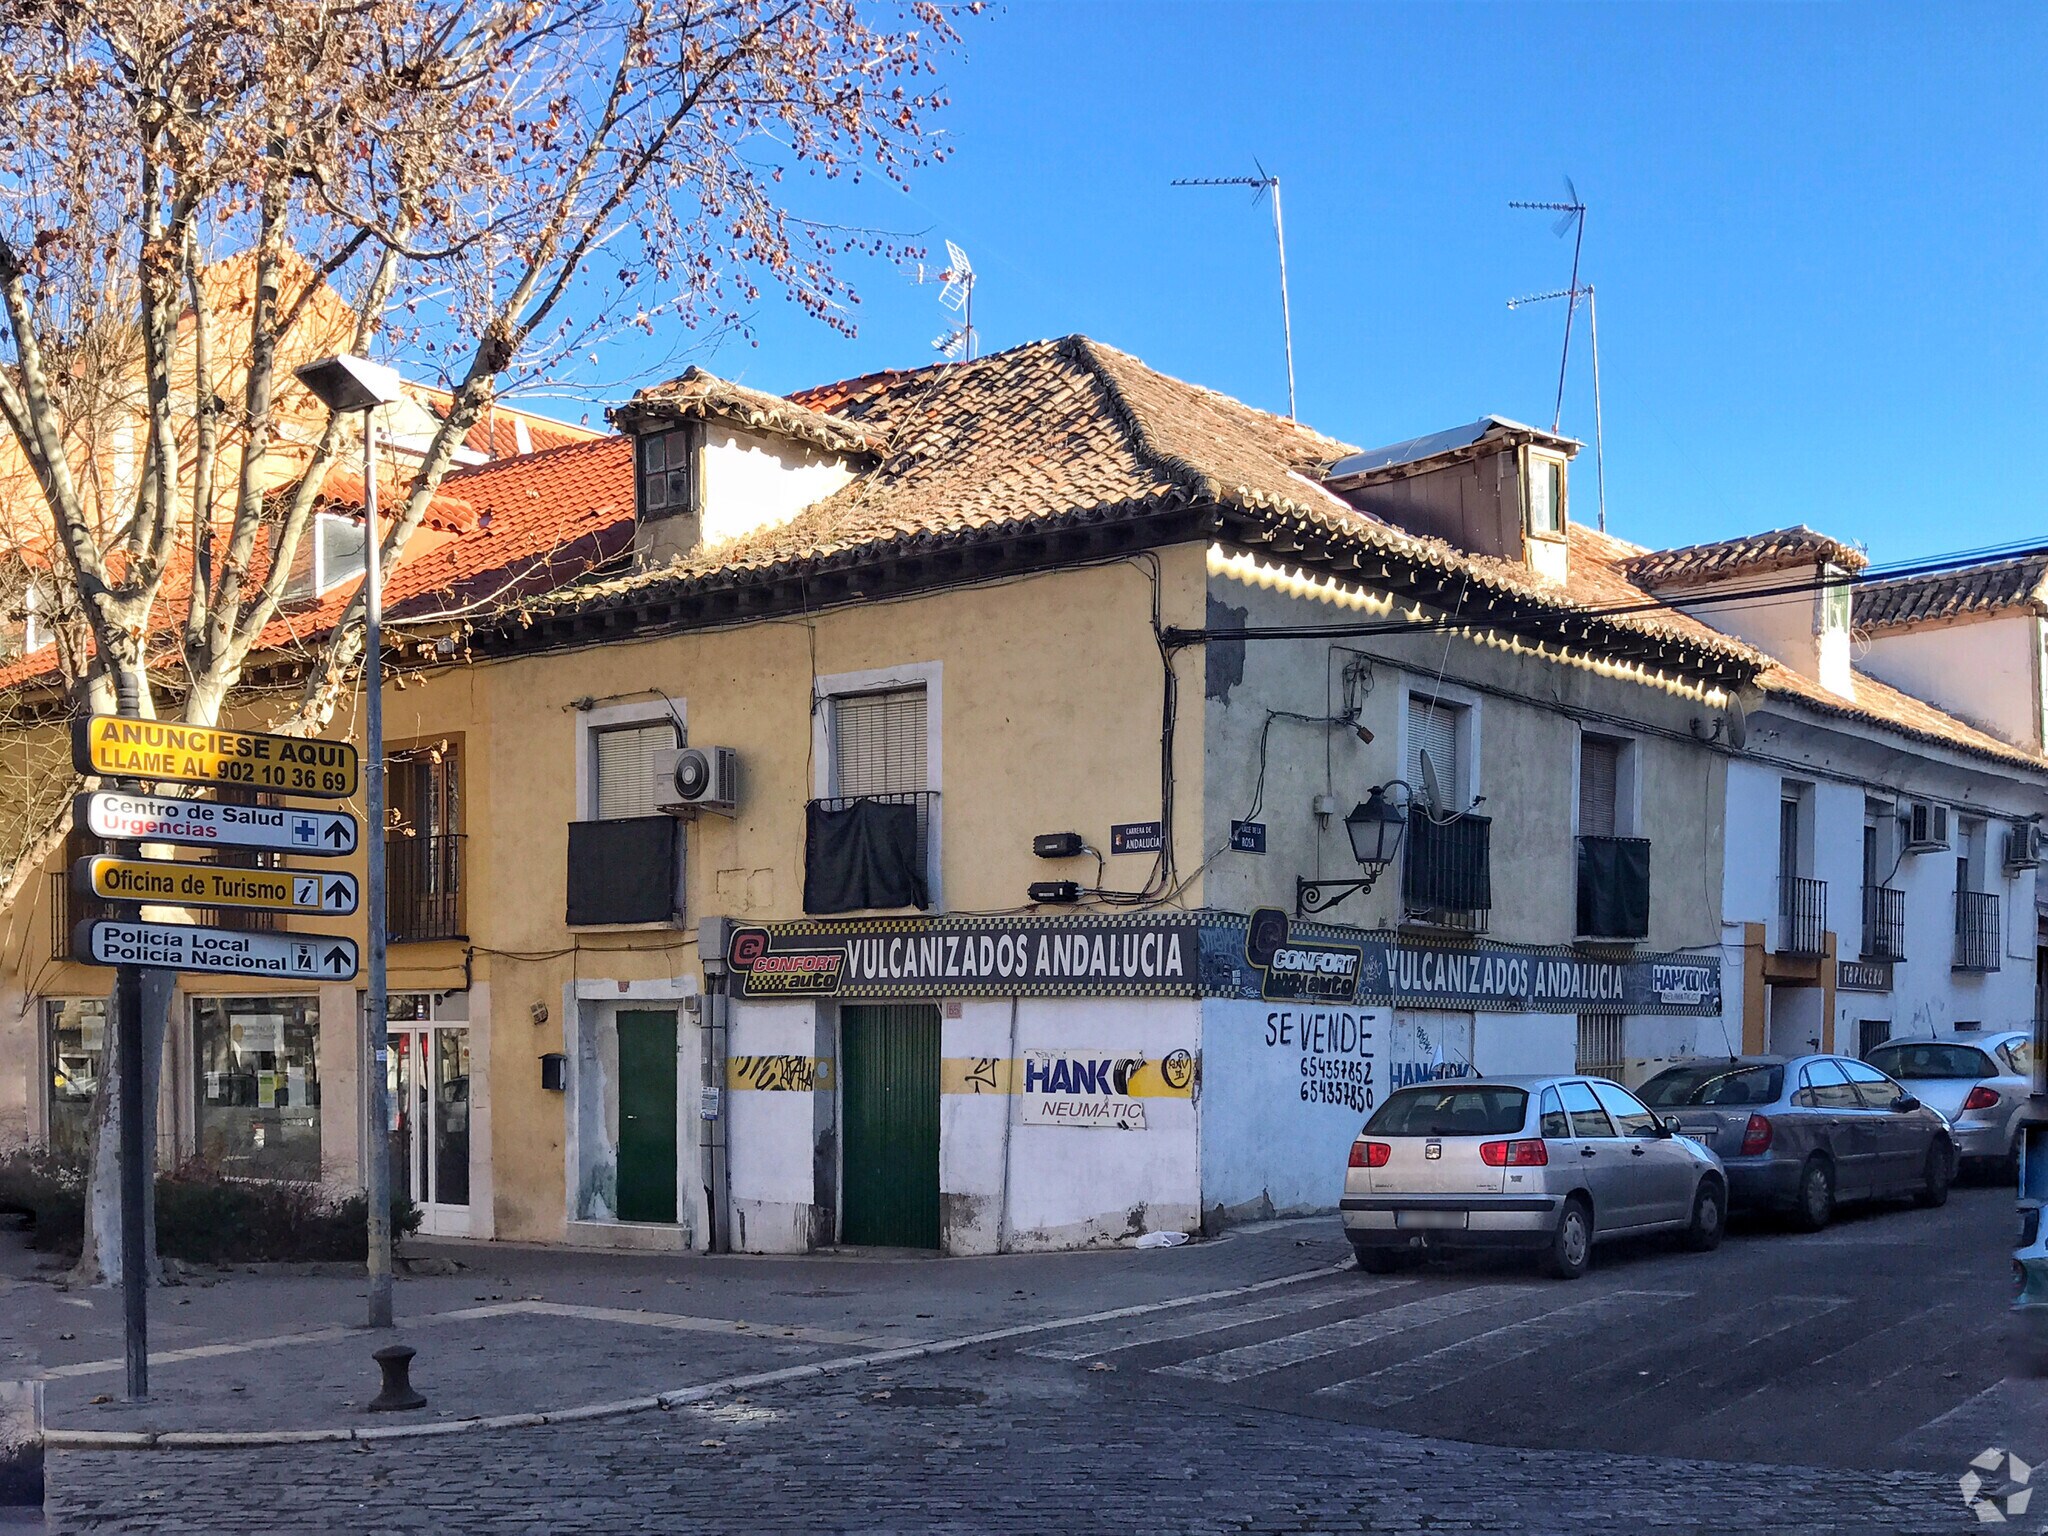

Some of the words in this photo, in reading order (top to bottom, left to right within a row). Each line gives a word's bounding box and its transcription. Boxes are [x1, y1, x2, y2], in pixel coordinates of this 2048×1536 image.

[101, 722, 270, 760] ANUNCIESE
[279, 742, 345, 768] AQUI
[100, 748, 175, 774] LLAME
[183, 758, 210, 778] AL
[217, 761, 254, 782] 902
[262, 765, 285, 786] 10
[291, 768, 316, 789] 36
[322, 772, 346, 791] 69
[103, 797, 178, 818] Centro
[187, 802, 214, 820] de
[222, 807, 284, 827] Salud
[104, 815, 218, 838] Urgencias
[1125, 835, 1161, 850] ANDALUCÍA
[104, 868, 174, 894] Oficina
[181, 873, 205, 895] de
[212, 875, 287, 900] Turismo
[104, 927, 183, 948] Policía
[192, 934, 249, 952] Local
[104, 944, 183, 964] Policía
[191, 951, 287, 971] Nacional
[753, 954, 842, 973] CONFORT
[847, 933, 1028, 980] VULCANIZADOS
[1034, 932, 1183, 978] ANDALUCIA
[1272, 948, 1357, 974] CONFORT
[788, 972, 837, 988] auto
[1386, 949, 1527, 996] VULCANIZADOS
[1534, 961, 1623, 1000] ANDALUCIA
[1265, 1012, 1294, 1047] SE
[1301, 1013, 1375, 1057] VENDE
[1301, 1056, 1374, 1086] 654357852
[1042, 1101, 1145, 1120] NEUMATIC
[1301, 1080, 1374, 1113] 654357850
